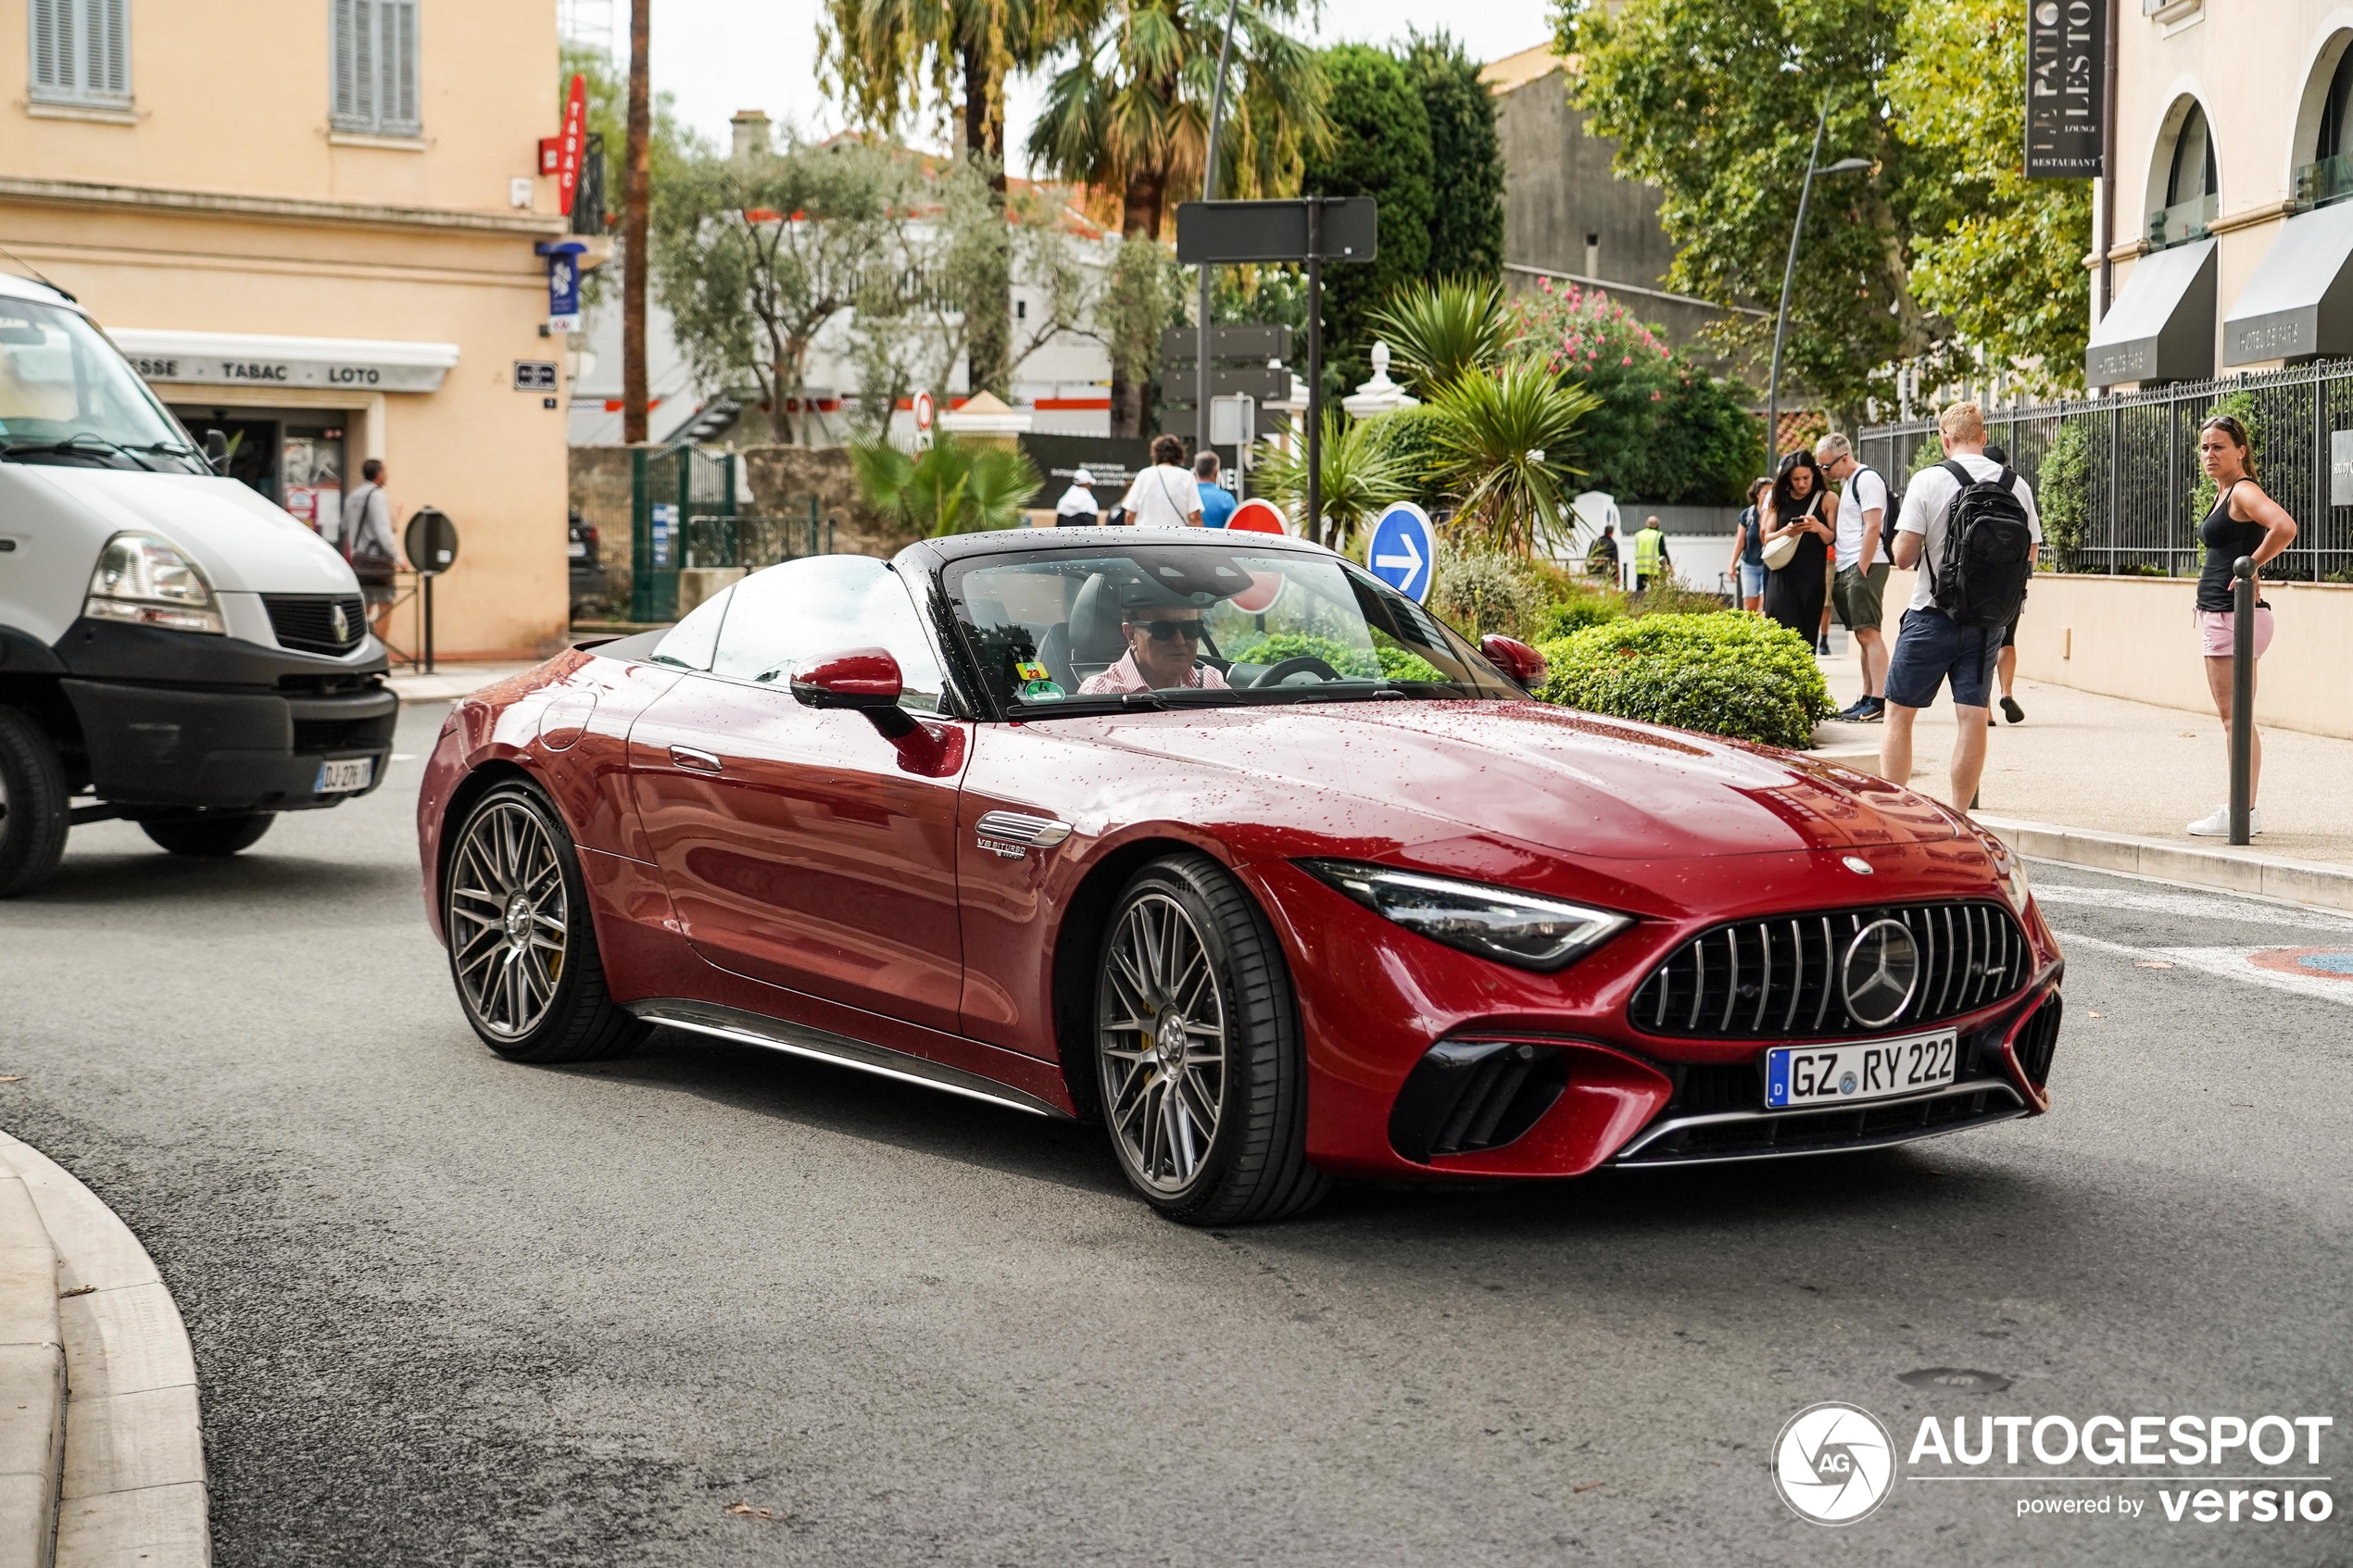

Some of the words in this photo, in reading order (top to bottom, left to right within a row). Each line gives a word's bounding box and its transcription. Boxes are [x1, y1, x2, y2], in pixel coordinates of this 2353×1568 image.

[2033, 1, 2059, 97] PATIO
[2065, 55, 2090, 117] LES
[2065, 124, 2097, 133] LOUNGE
[562, 101, 581, 188] TABAC
[2032, 157, 2097, 168] RESTAURANT
[2239, 330, 2263, 352] HOTEL
[2265, 326, 2275, 347] DE
[2277, 322, 2298, 345] PARIS
[221, 361, 288, 382] TABAC
[329, 367, 381, 384] LOTO
[1026, 670, 1041, 679] 23
[992, 841, 1026, 854] BITURBO
[1774, 1083, 1783, 1097] D
[1793, 1053, 1838, 1098] GZ
[1863, 1046, 1902, 1091] RY
[1907, 1037, 1954, 1085] 222
